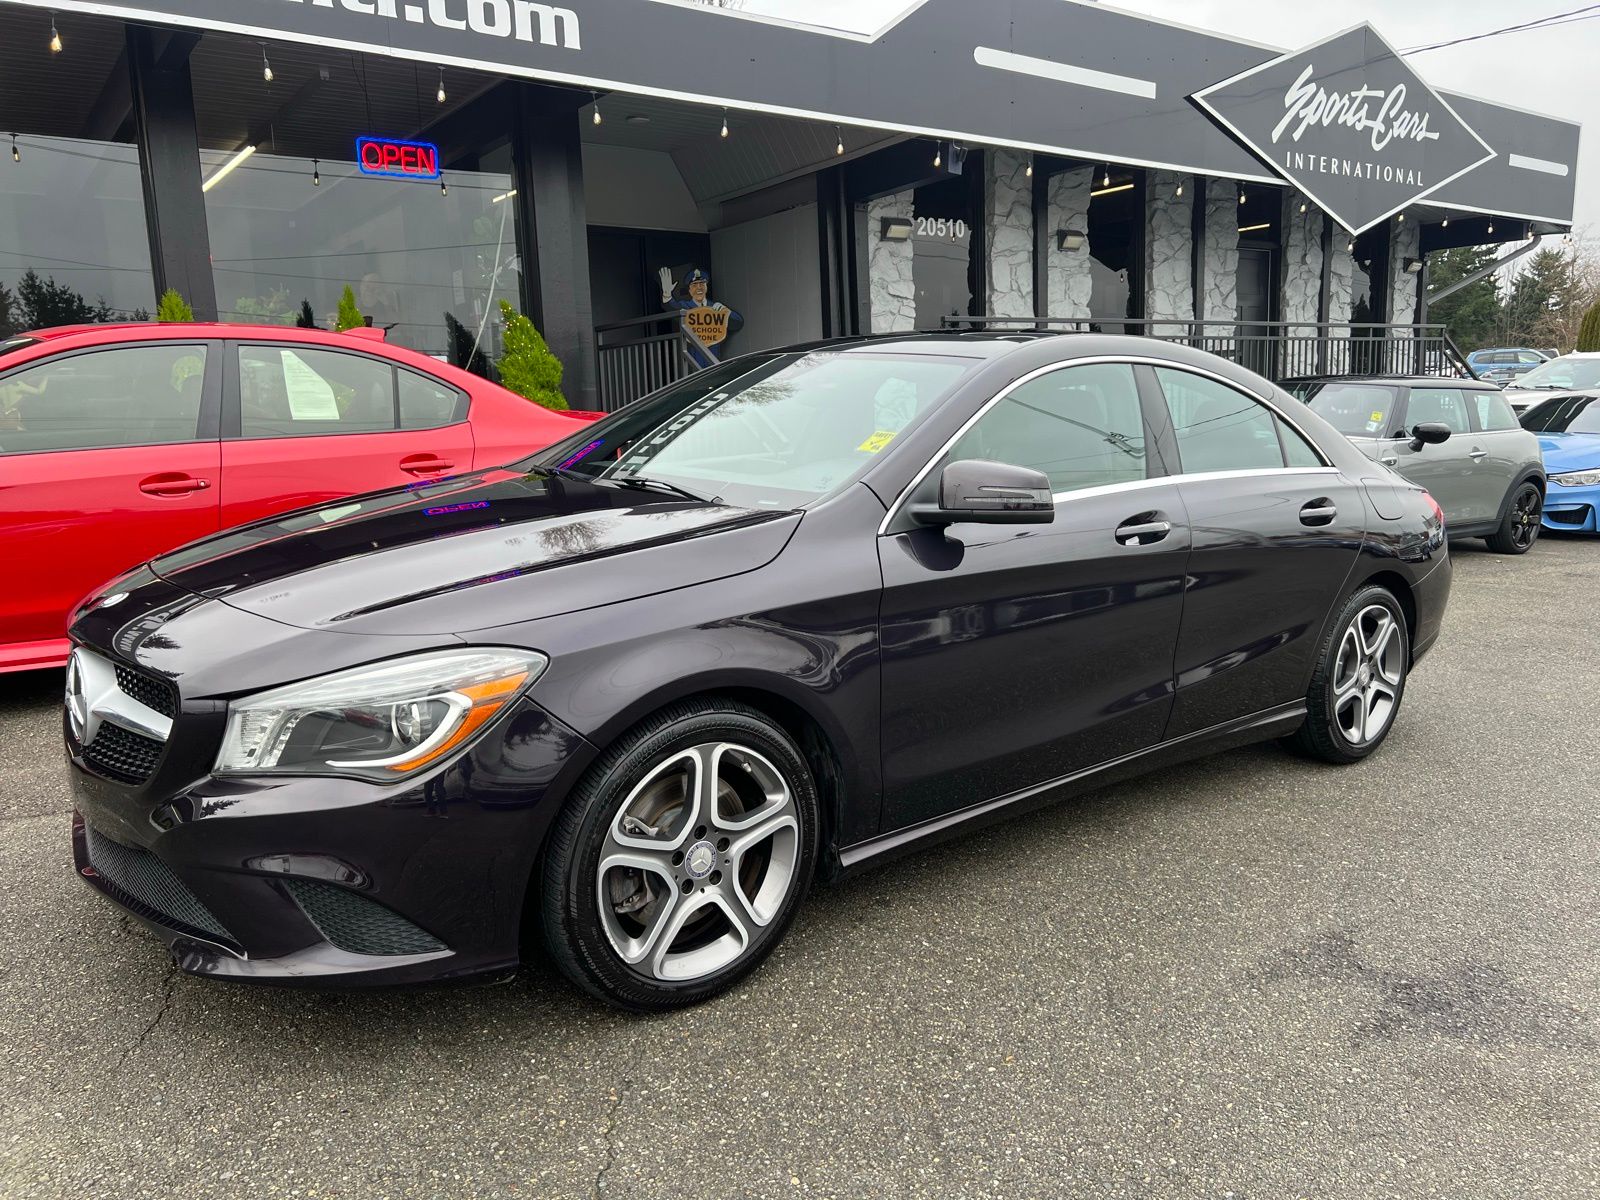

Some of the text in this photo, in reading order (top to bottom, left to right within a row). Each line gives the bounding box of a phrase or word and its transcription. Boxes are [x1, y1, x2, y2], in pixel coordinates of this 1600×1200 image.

[1271, 64, 1440, 151] Sports Cars
[362, 142, 435, 174] OPEN
[1286, 151, 1424, 186] INTERNATIONAL
[917, 216, 965, 238] 20510
[688, 313, 725, 326] SLOW
